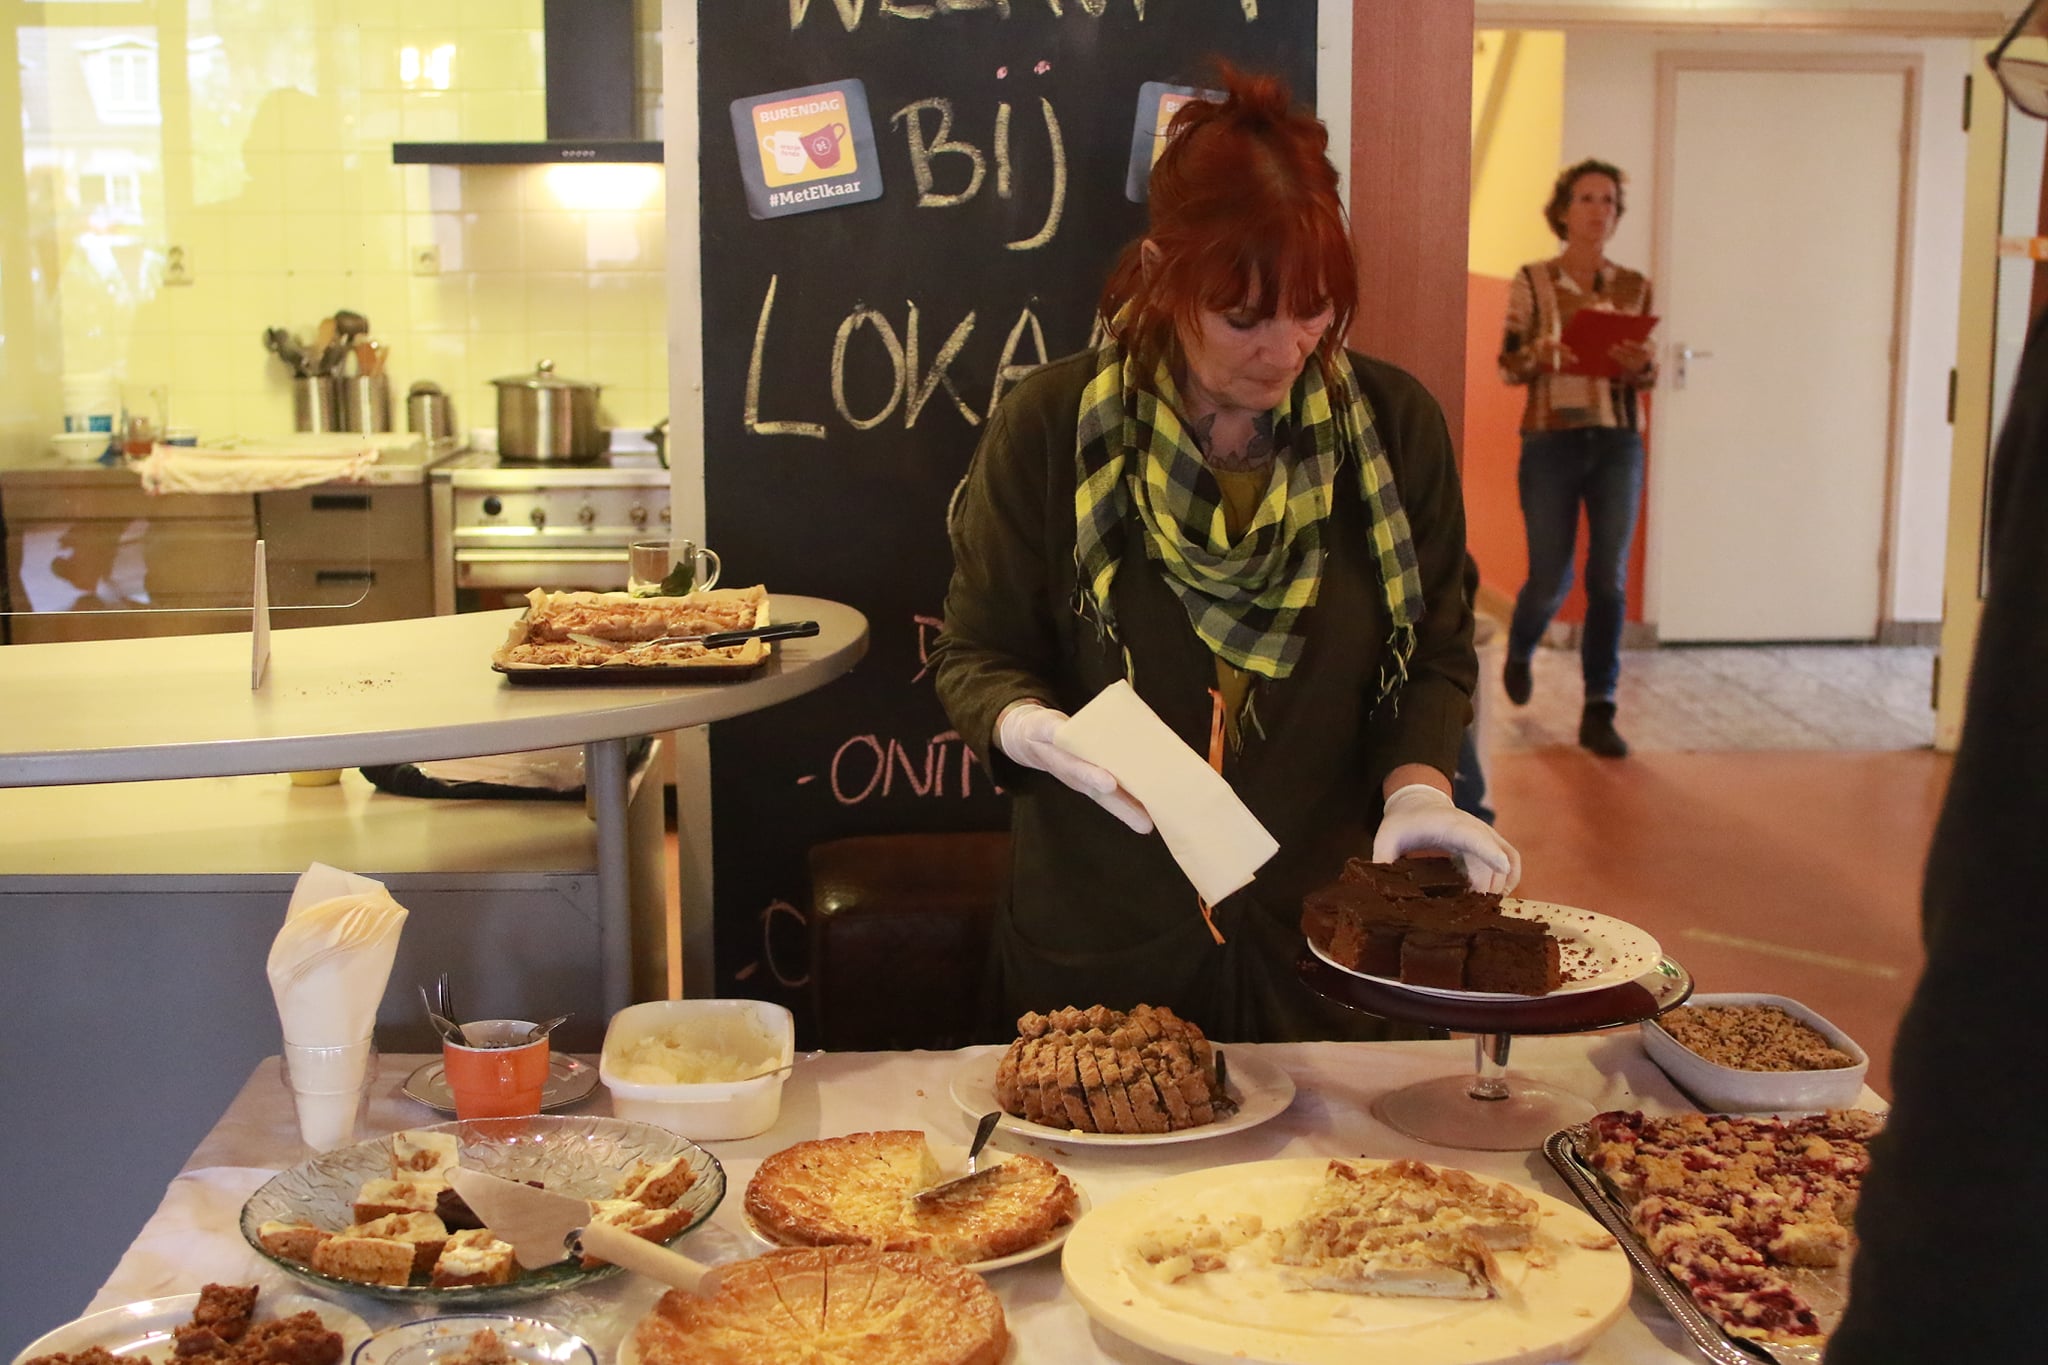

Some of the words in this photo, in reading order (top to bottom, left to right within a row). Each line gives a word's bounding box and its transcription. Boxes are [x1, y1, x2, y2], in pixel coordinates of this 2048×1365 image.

[759, 98, 840, 123] BURENDAG
[769, 181, 861, 208] #MetElkaar
[745, 273, 1104, 441] LOKA
